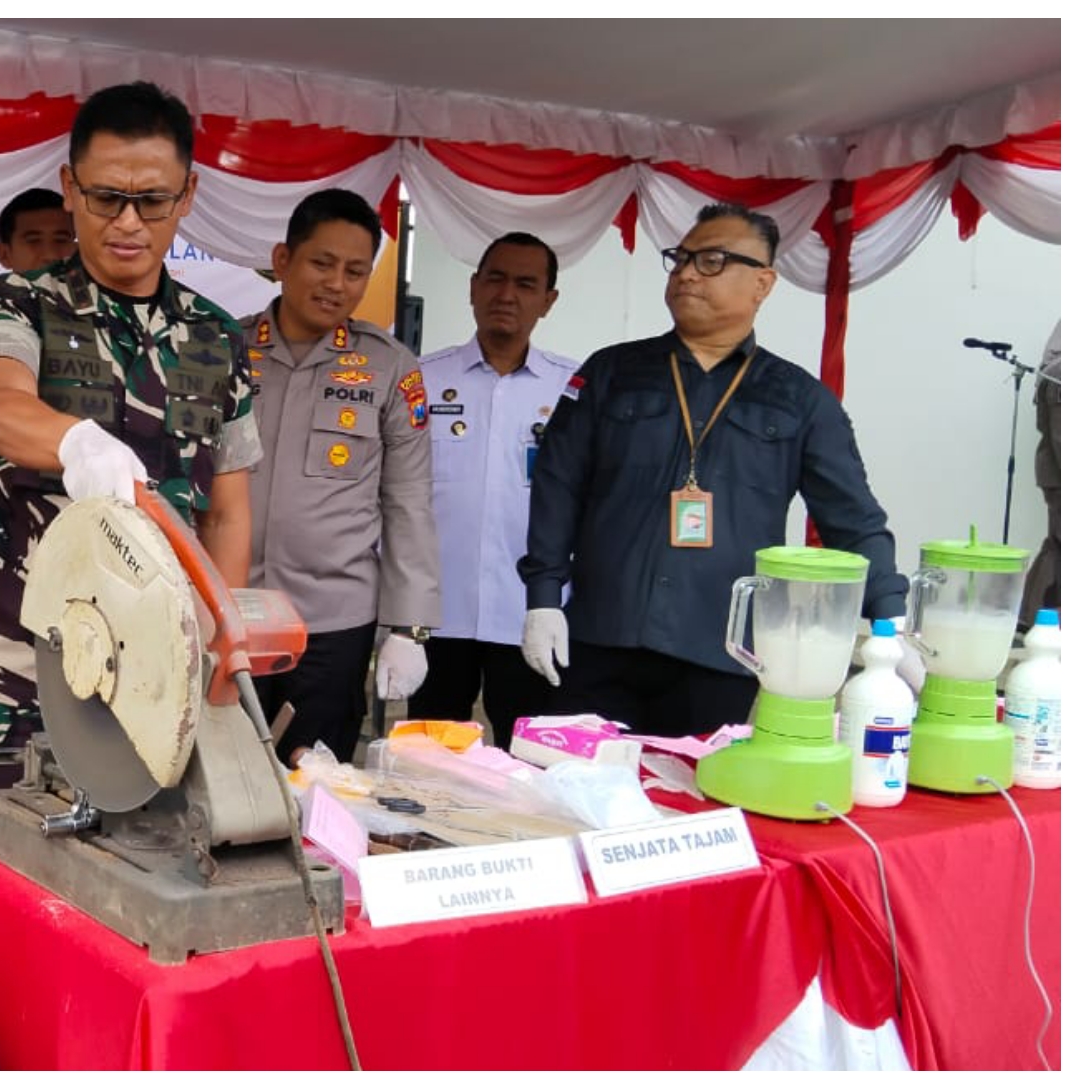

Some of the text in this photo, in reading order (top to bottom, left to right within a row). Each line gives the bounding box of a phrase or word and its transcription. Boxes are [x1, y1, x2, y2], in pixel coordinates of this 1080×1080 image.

[48, 358, 100, 377] BAYU
[178, 374, 204, 392] TNI
[324, 387, 374, 404] POLRI
[100, 516, 144, 578] maktec
[601, 826, 738, 864] SENJATA TAJAM
[404, 857, 533, 884] BARANG BUKTI
[438, 886, 516, 908] LAINNYA
